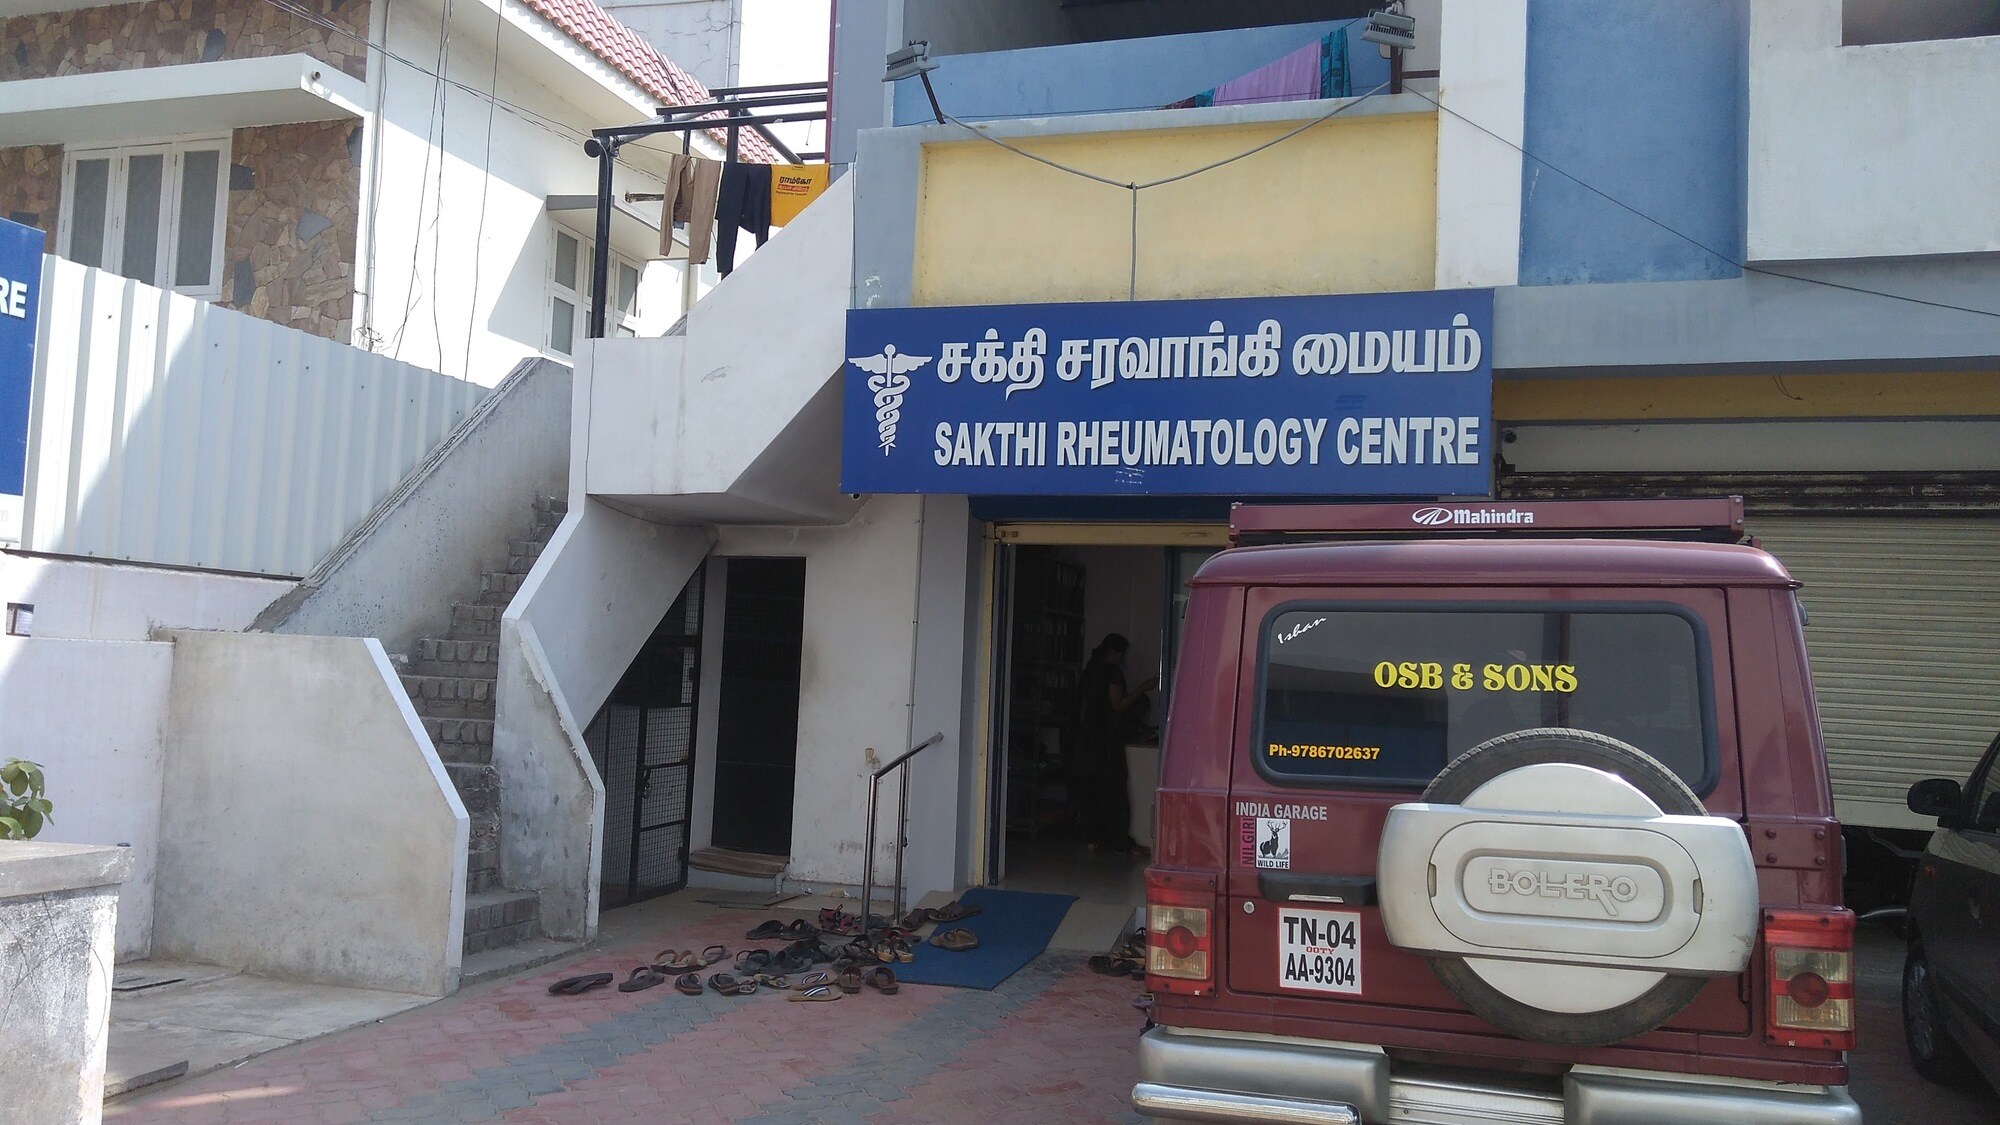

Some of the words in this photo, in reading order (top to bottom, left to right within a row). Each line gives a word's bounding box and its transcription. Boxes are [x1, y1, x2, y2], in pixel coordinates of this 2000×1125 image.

[937, 327, 1047, 401] சக்தி
[1056, 319, 1282, 390] சரவாங்கி
[1292, 313, 1482, 375] மையம்
[934, 421, 1047, 466] SAKTHI
[1056, 418, 1328, 467] RHEUMATOLOGY
[1337, 416, 1480, 465] CENTRE
[1453, 509, 1534, 525] Mahindra
[1277, 617, 1327, 645] Ishan
[1374, 661, 1444, 690] OSB
[1451, 663, 1474, 690] &
[1483, 663, 1578, 693] SONS
[1269, 744, 1380, 760] Ph-9786702637
[1235, 801, 1271, 818] INDIA
[1273, 803, 1328, 821] GARAGE
[1241, 817, 1255, 866] NILGIRI
[1257, 859, 1274, 868] WILD
[1275, 860, 1289, 869] LIFE
[1488, 868, 1638, 916] BOLERO
[1283, 916, 1356, 950] TN-04
[1306, 946, 1335, 955] OOTY
[1285, 952, 1355, 986] AA-9304
